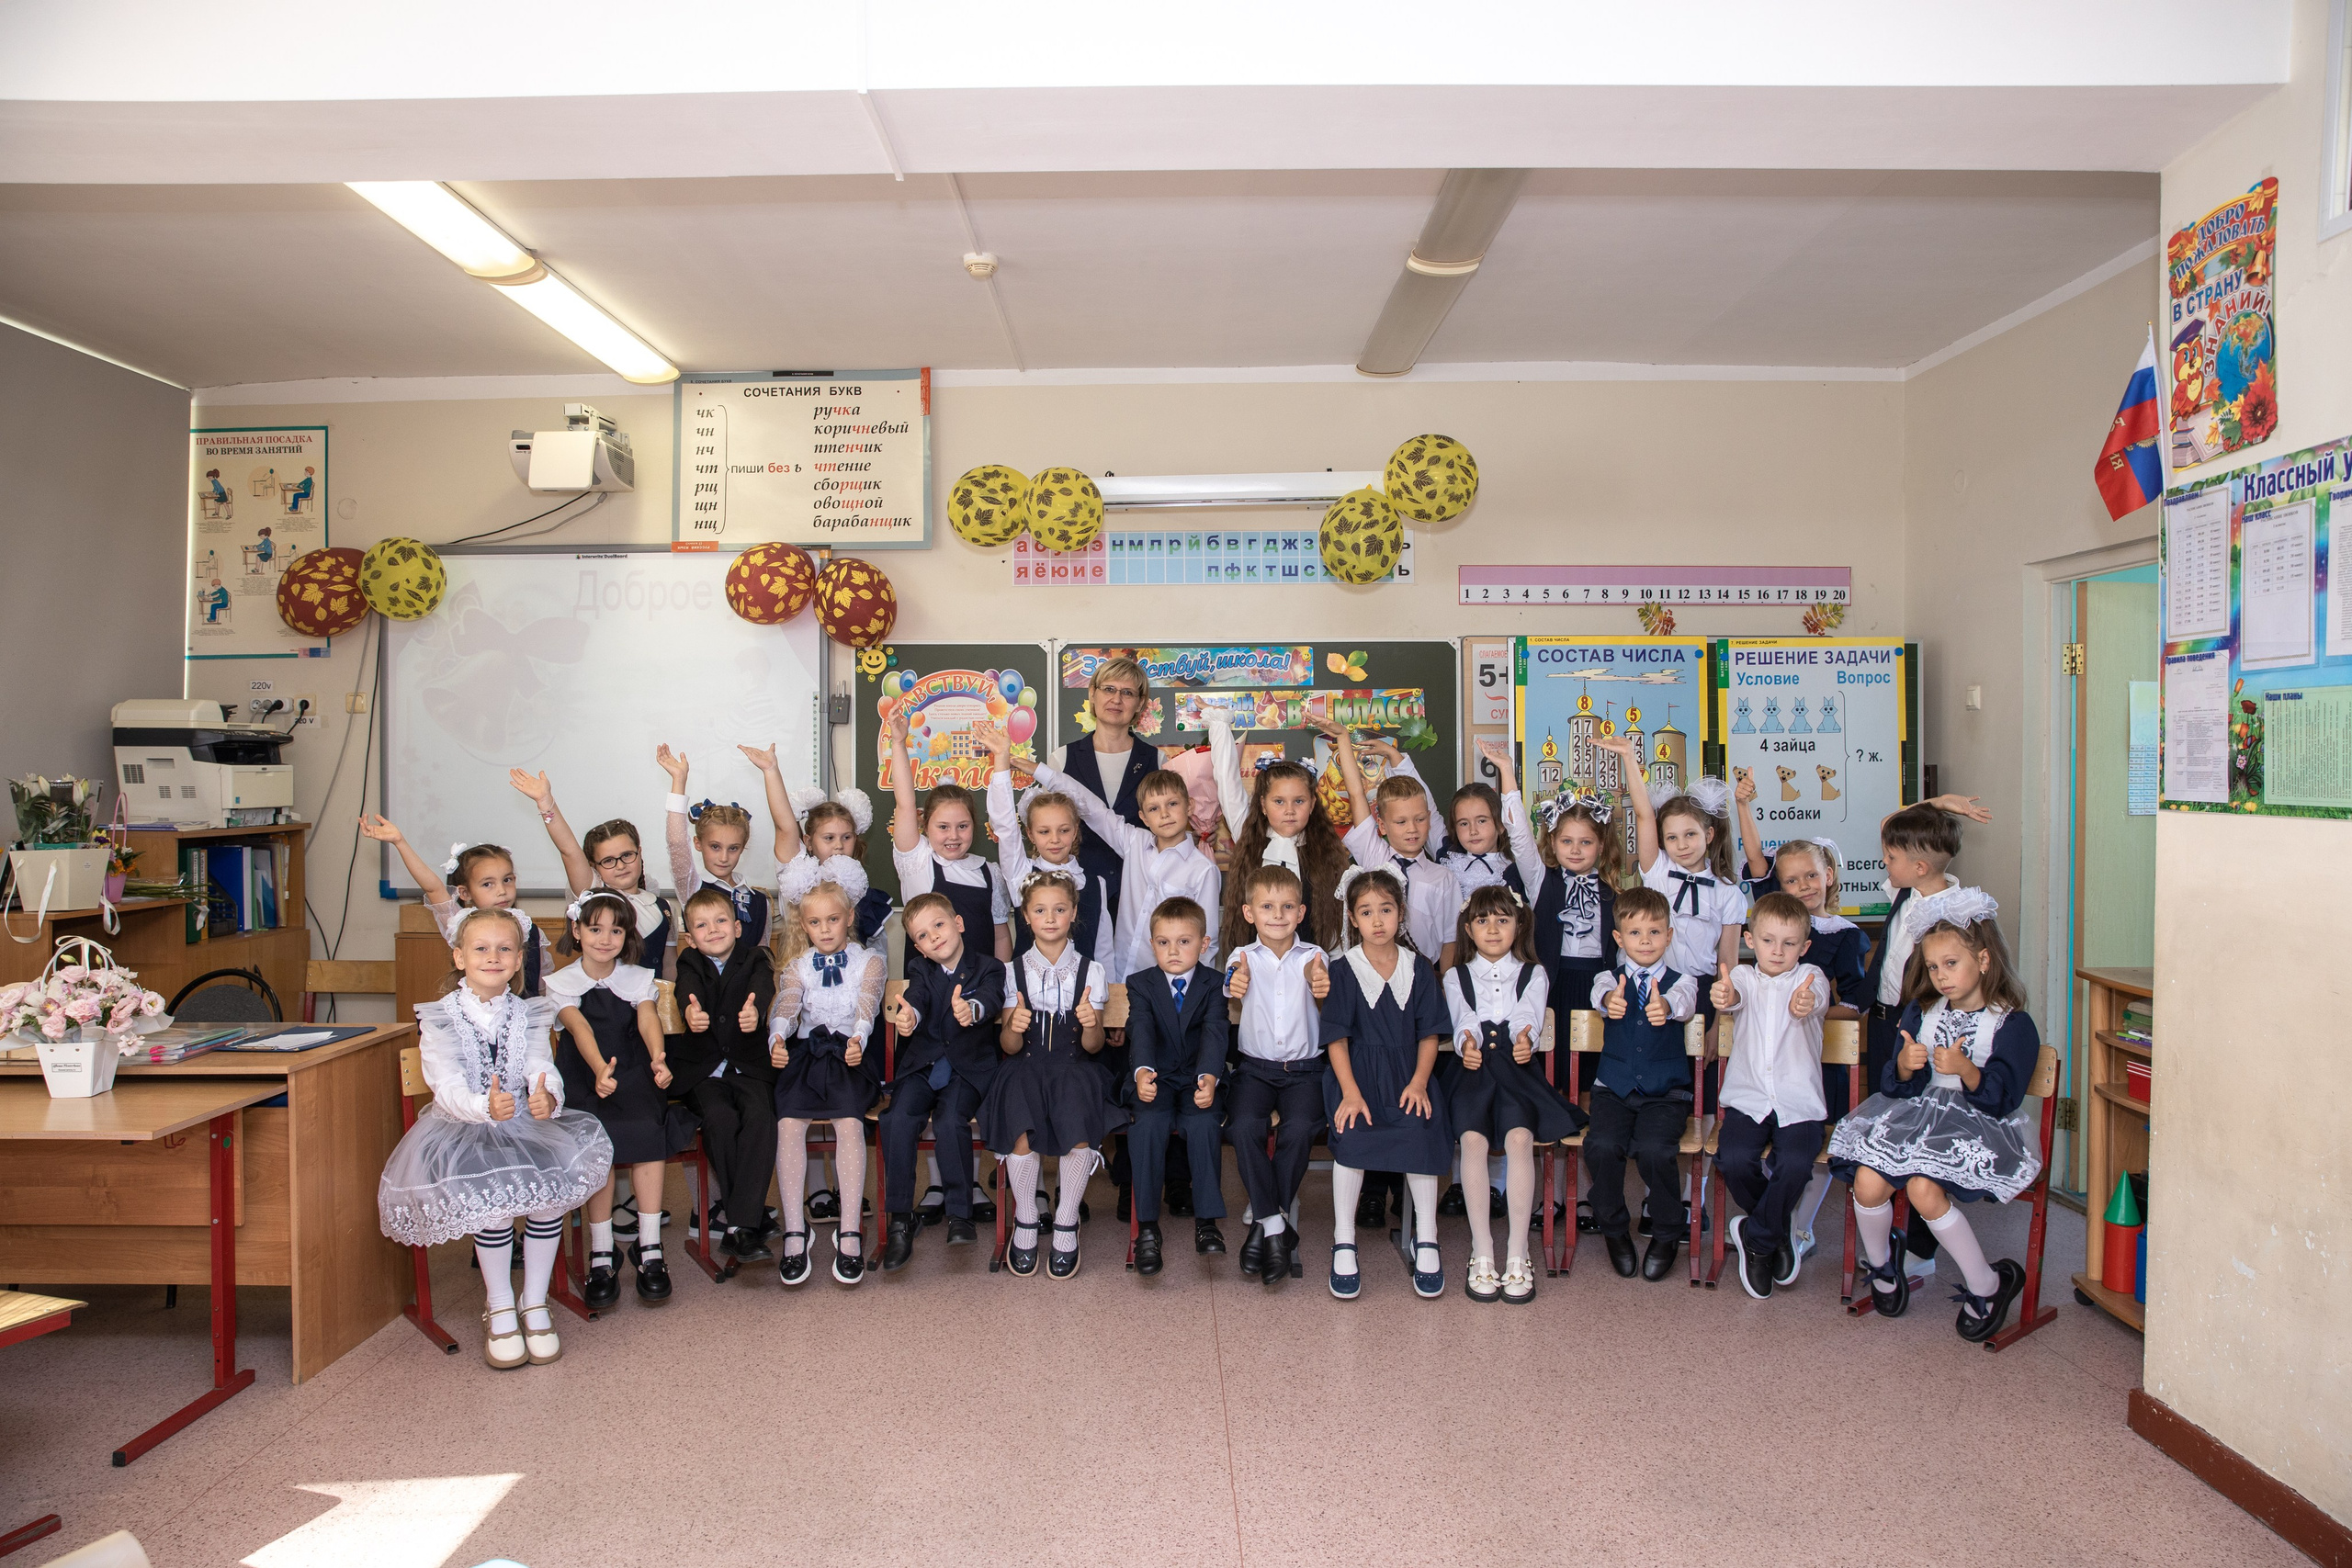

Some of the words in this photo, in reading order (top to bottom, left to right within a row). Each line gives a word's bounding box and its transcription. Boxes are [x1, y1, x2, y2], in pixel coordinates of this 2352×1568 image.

[2198, 202, 2245, 243] ДОБРО
[2175, 215, 2267, 281] ПОЖАЛОВАТЬ
[2173, 301, 2181, 323] В
[2187, 267, 2244, 317] СТРАНУ
[2204, 289, 2271, 378] ЗНАНИЙ!
[744, 387, 820, 398] СОЧЕТАНИЯ
[829, 386, 862, 396] БУКВ
[696, 409, 715, 419] чк
[814, 406, 861, 420] ручка
[696, 427, 714, 437] чн
[814, 421, 909, 437] коричневый
[196, 436, 263, 446] ПРАВИЛЬНАЯ
[266, 435, 312, 444] ПОСАДКА
[220, 446, 254, 455] ВРЕМЯ
[255, 446, 302, 454] ЗАНЯТИЙ
[696, 446, 714, 456] нч
[814, 443, 883, 454] птенчик
[695, 464, 718, 474] чт
[731, 464, 763, 473] пиши
[768, 463, 790, 473] без
[795, 464, 802, 473] ь
[814, 461, 871, 472] чтение
[2244, 451, 2335, 503] Классный
[695, 482, 718, 496] рщ
[814, 478, 882, 493] сборщик
[695, 502, 718, 512] щн
[813, 497, 884, 512] овощной
[813, 514, 911, 531] барабанщик
[2242, 514, 2254, 524] Наш
[2255, 510, 2271, 520] класс
[695, 520, 718, 532] нщ
[1017, 541, 1027, 552] а
[1091, 540, 1102, 551] э
[1112, 540, 1123, 551] н
[1128, 540, 1144, 551] м
[1147, 540, 1161, 551] л
[1170, 540, 1181, 555] р
[1188, 536, 1200, 551] й
[1207, 535, 1219, 551] б
[1227, 540, 1239, 551] в
[1248, 540, 1257, 551] г
[1264, 540, 1278, 554] д
[1283, 540, 1298, 550] ж
[1304, 538, 1314, 550] з
[1016, 566, 1028, 578] я
[1035, 563, 1046, 578] ё
[1051, 566, 1069, 577] ю
[1074, 566, 1084, 577] и
[1091, 565, 1103, 577] е
[1207, 566, 1218, 577] п
[1225, 562, 1241, 581] ф
[1246, 566, 1257, 577] к
[1265, 566, 1276, 577] т
[1283, 565, 1298, 577] ш
[1304, 565, 1315, 577] с
[1398, 565, 1409, 576] ь
[573, 570, 713, 621] Доброе
[1464, 589, 1470, 600] 1
[1482, 589, 1489, 600] 2
[1503, 589, 1510, 600] 3
[1522, 589, 1530, 600] 4
[1543, 589, 1550, 600] 5
[1563, 589, 1569, 600] 6
[1584, 589, 1589, 600] 7
[1601, 589, 1609, 600] 8
[1623, 589, 1629, 600] 9
[1640, 589, 1652, 601] 10
[1659, 589, 1670, 601] 11
[1678, 589, 1690, 601] 12
[1699, 589, 1711, 601] 13
[1717, 589, 1729, 601] 14
[1738, 589, 1750, 601] 15
[1757, 589, 1770, 601] 16
[1777, 589, 1789, 601] 17
[1794, 589, 1807, 601] 18
[1815, 590, 1826, 601] 19
[1832, 590, 1846, 601] 20
[1216, 654, 1292, 671] школа!
[1537, 649, 1615, 663] СОСТАВ
[1623, 649, 1685, 663] ЧИСЛА
[1735, 650, 1818, 666] РЕШЕНИЕ
[1825, 649, 1891, 665] ЗАДАЧИ
[2165, 656, 2186, 666] Правила
[2187, 651, 2215, 662] поведения
[1736, 672, 1800, 685] Условие
[1838, 671, 1891, 686] Вопрос
[1581, 696, 1589, 710] 8
[2266, 692, 2281, 701] Наши
[2283, 692, 2302, 701] планы
[1286, 699, 1302, 726] В
[1630, 708, 1637, 722] 5
[1574, 720, 1579, 733] 1
[1585, 720, 1591, 732] 7
[1604, 720, 1611, 735] 6
[1574, 735, 1580, 748] 2
[1636, 736, 1643, 748] 4
[1760, 739, 1769, 751] 4
[1773, 739, 1815, 753] зайца
[1545, 742, 1553, 756] 3
[1659, 744, 1667, 758] 4
[1574, 750, 1580, 762] 3
[1585, 750, 1591, 761] 5
[1636, 751, 1642, 763] 3
[1856, 750, 1863, 762] ?
[1869, 751, 1883, 762] ж.
[1481, 756, 1496, 777] 6
[1574, 764, 1581, 776] 4
[1585, 764, 1591, 776] 4
[1600, 761, 1606, 774] 2
[1610, 761, 1616, 773] 4
[1657, 767, 1661, 779] 1
[1668, 766, 1673, 778] 3
[1543, 769, 1547, 782] 1
[1552, 769, 1558, 782] 2
[1600, 775, 1606, 788] 3
[1610, 775, 1616, 788] 3
[1629, 811, 1634, 823] 1
[1757, 808, 1764, 820] 3
[1770, 807, 1821, 820] собаки
[1628, 827, 1634, 839] 2
[1628, 840, 1634, 853] 3
[1848, 860, 1885, 870] всего
